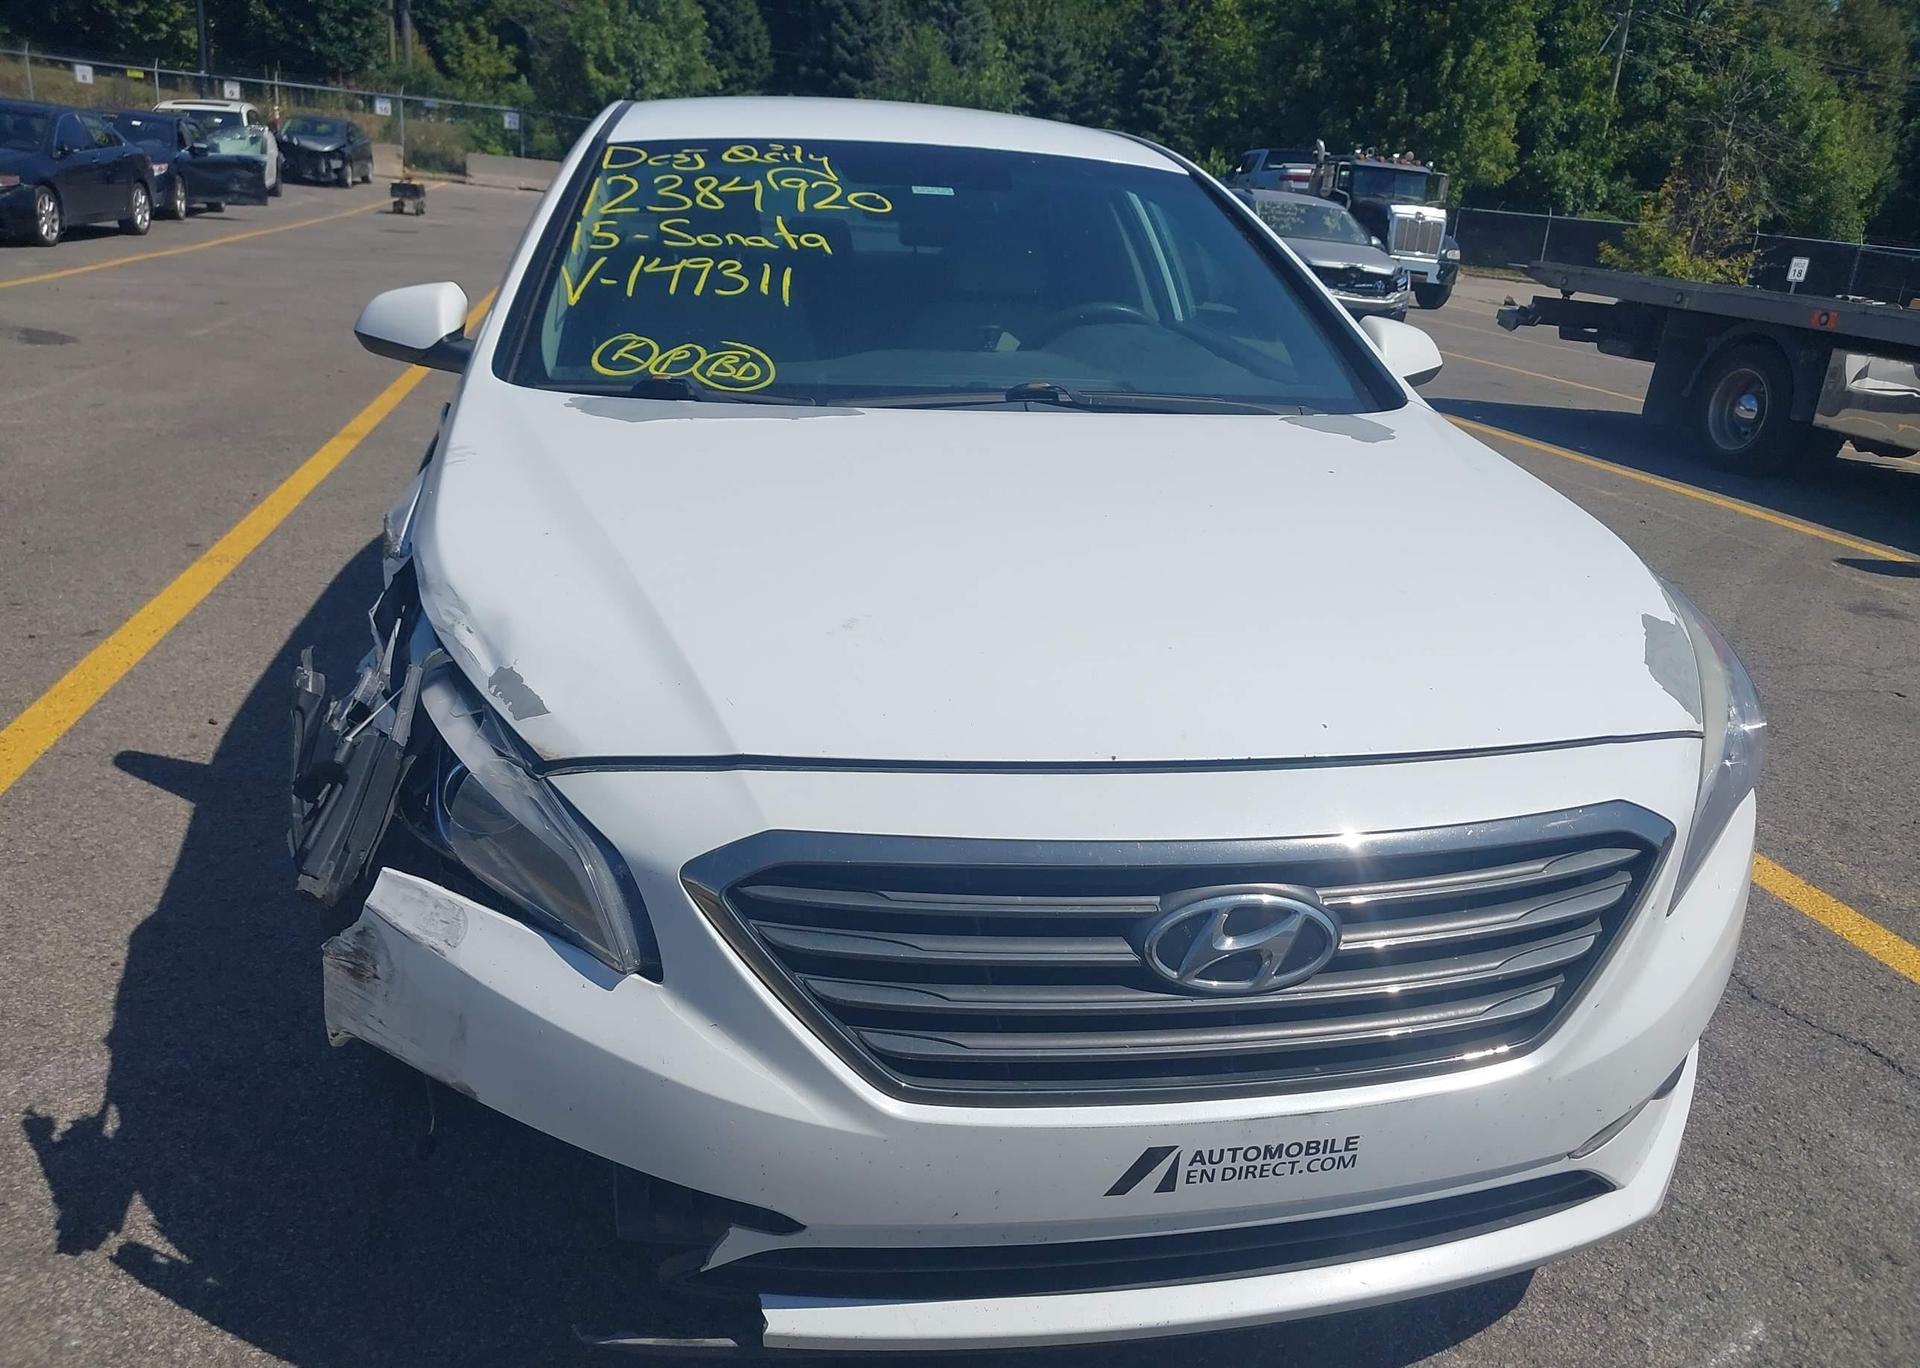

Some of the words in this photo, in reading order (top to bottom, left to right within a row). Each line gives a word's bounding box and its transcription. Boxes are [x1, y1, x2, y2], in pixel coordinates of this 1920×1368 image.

[1792, 268, 1803, 278] 18
[1187, 1136, 1360, 1167] AUTOMOBILE
[1185, 1168, 1216, 1185] EN
[1221, 1154, 1358, 1182] DIRECT.COM
